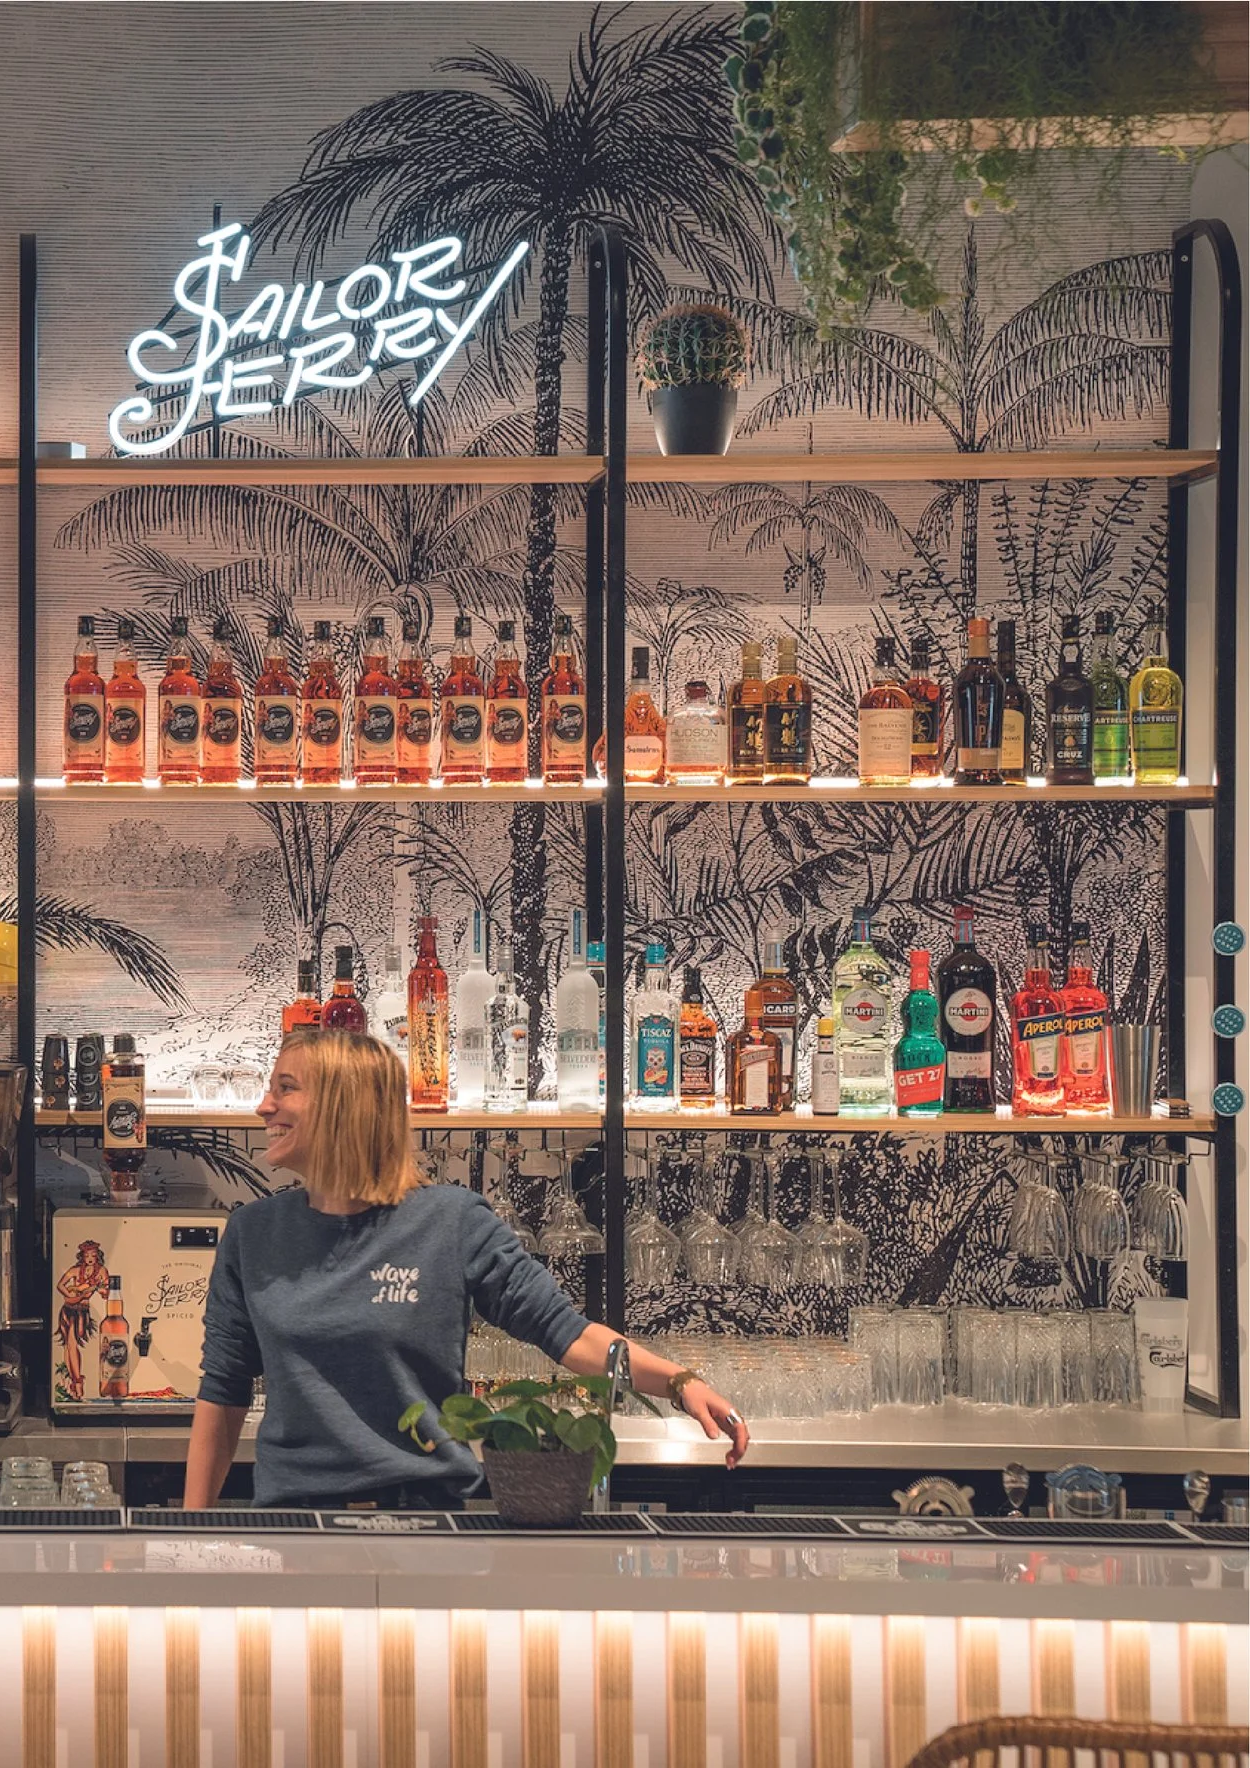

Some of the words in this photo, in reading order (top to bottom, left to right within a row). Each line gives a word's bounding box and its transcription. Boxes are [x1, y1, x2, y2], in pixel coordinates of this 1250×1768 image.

[1051, 713, 1091, 723] RESERVE
[1095, 716, 1129, 724] ARTREUSE
[670, 728, 719, 737] HUDSON
[1057, 751, 1083, 759] CRUZ
[763, 1004, 796, 1014] ICARD
[845, 1007, 884, 1017] MARTINI
[950, 1007, 989, 1017] MARTINI
[1023, 1018, 1063, 1037] APEROL
[1064, 1015, 1104, 1033] APEROL
[898, 1072, 925, 1086] GET
[928, 1069, 941, 1082] 27
[370, 1263, 420, 1283] wave
[388, 1278, 420, 1304] life
